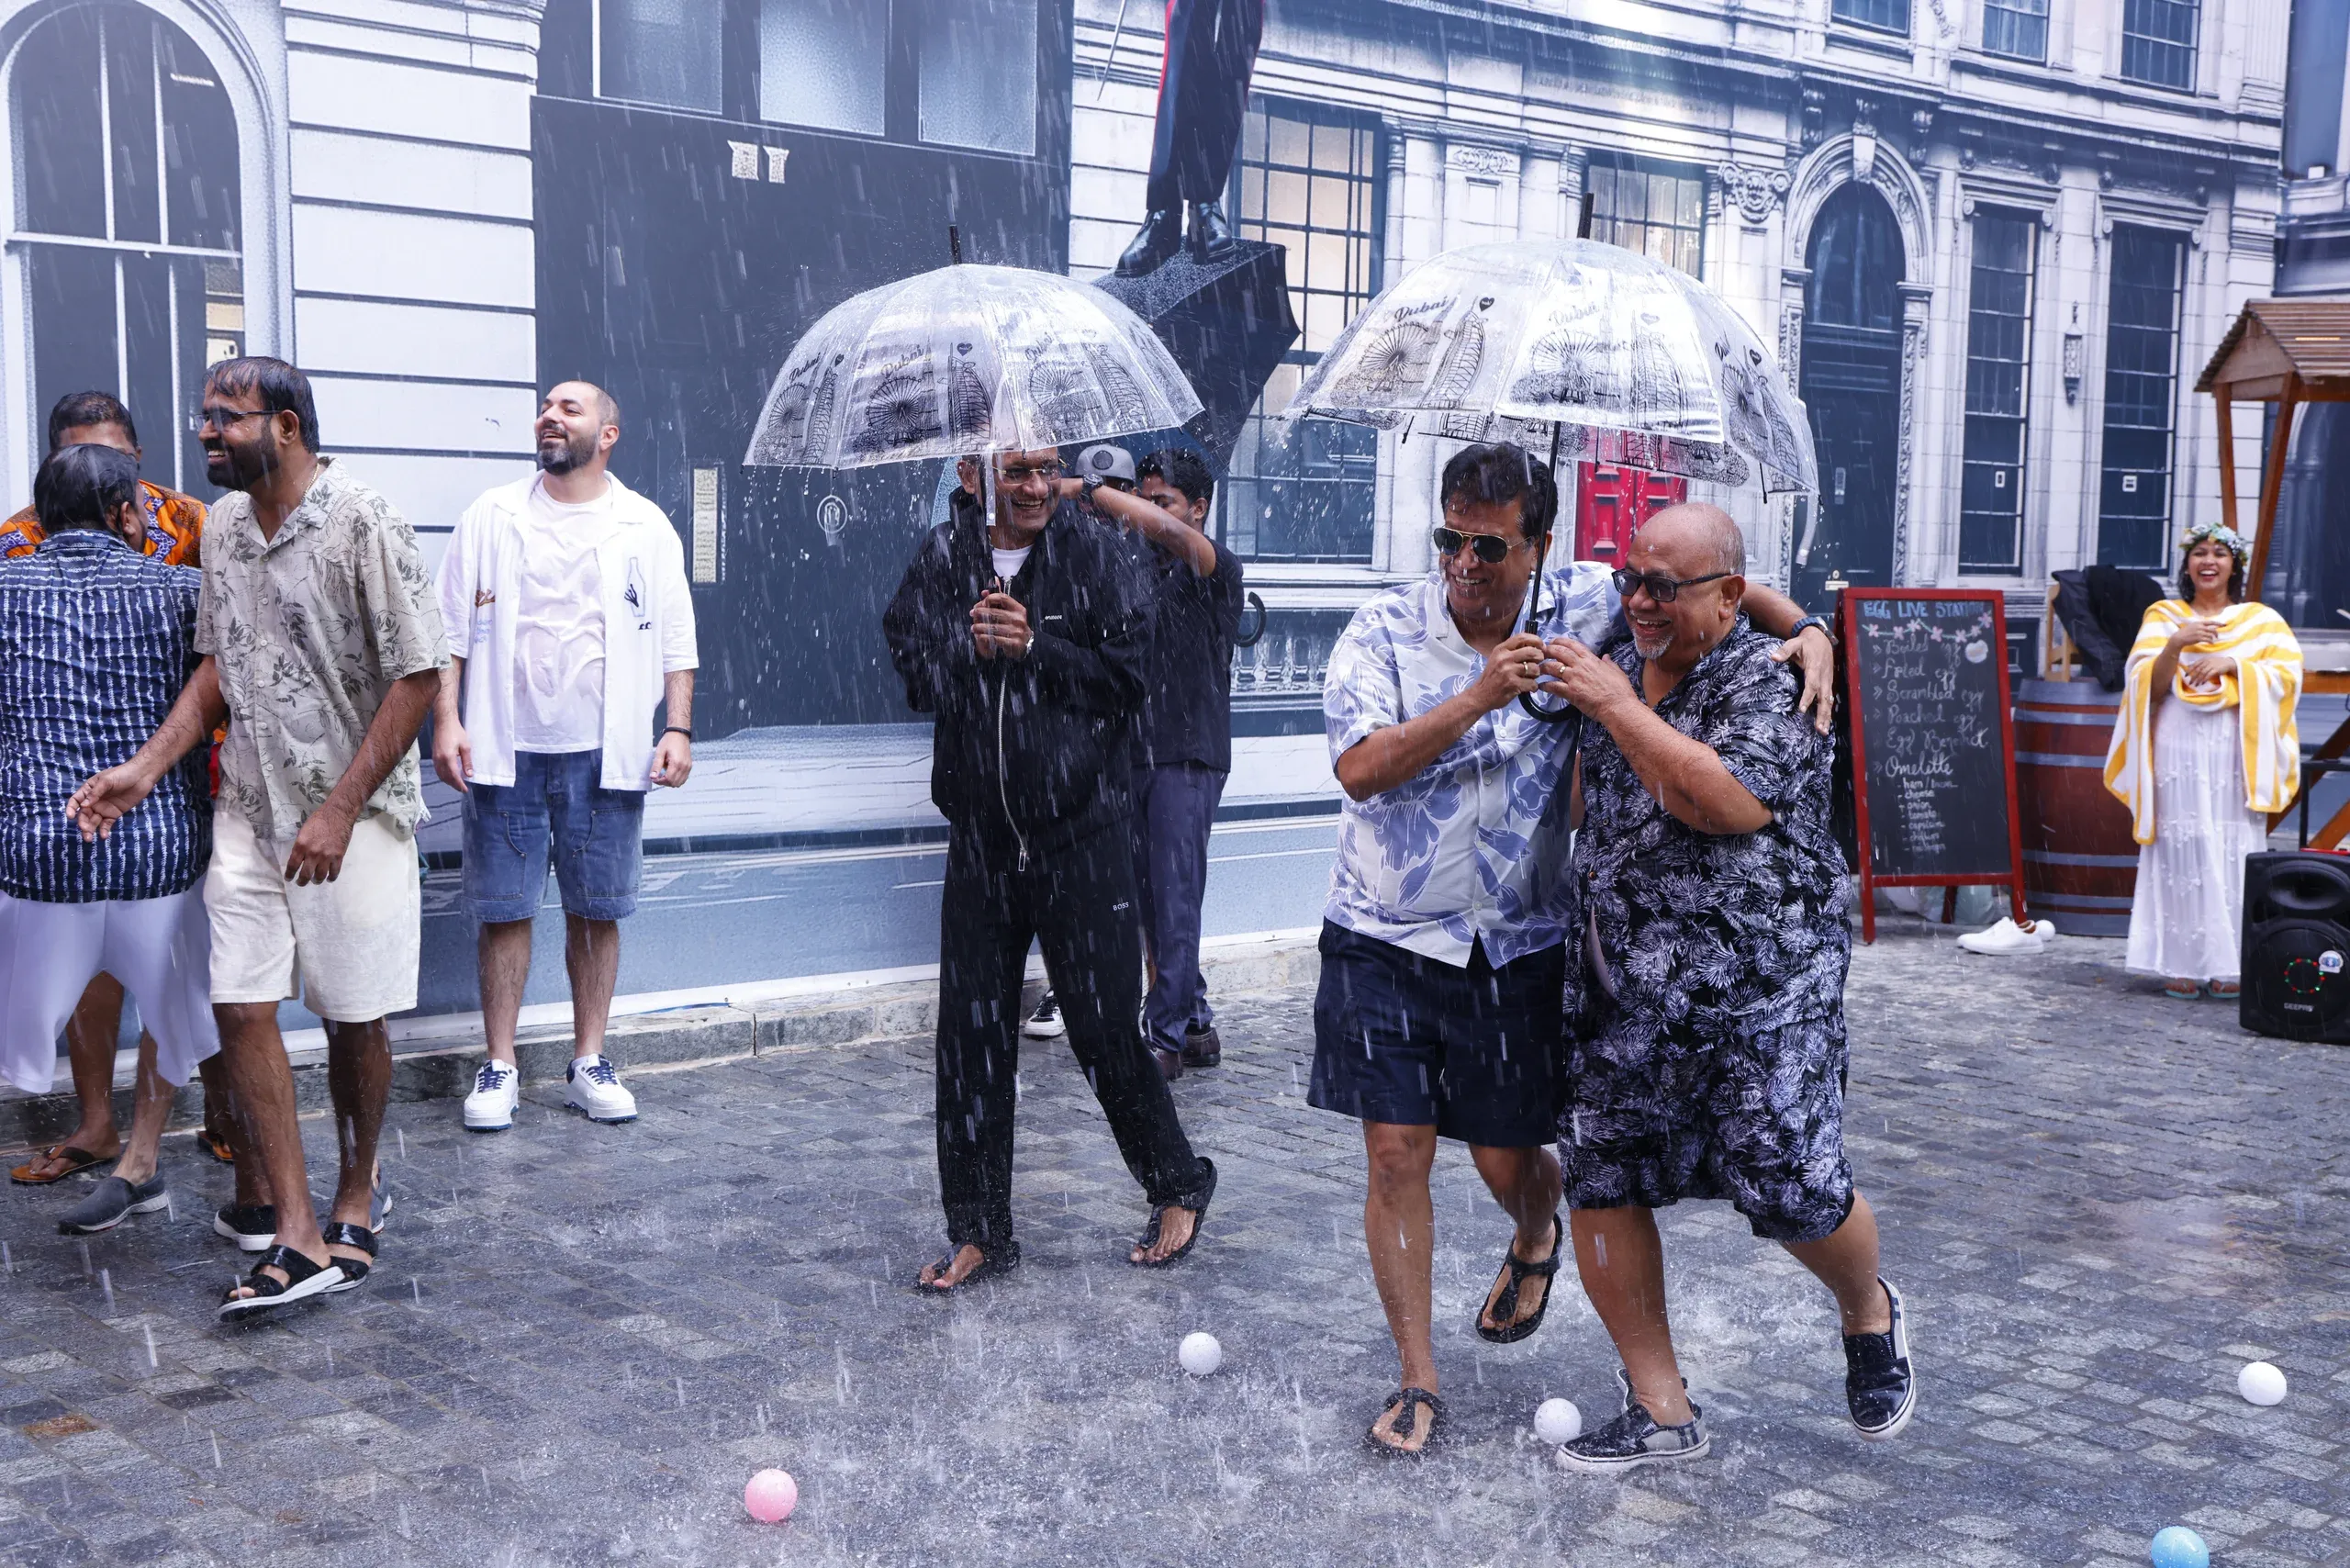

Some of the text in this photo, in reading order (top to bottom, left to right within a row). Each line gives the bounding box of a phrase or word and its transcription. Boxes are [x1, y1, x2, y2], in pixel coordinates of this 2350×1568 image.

[1393, 296, 1449, 322] Dubai
[789, 352, 821, 383] Dubai
[881, 343, 924, 378] Dubai
[1863, 601, 1891, 619] EGG
[1897, 601, 1929, 618] LIVE
[1885, 750, 1953, 778] Omelette
[1113, 902, 1129, 912] BOSS
